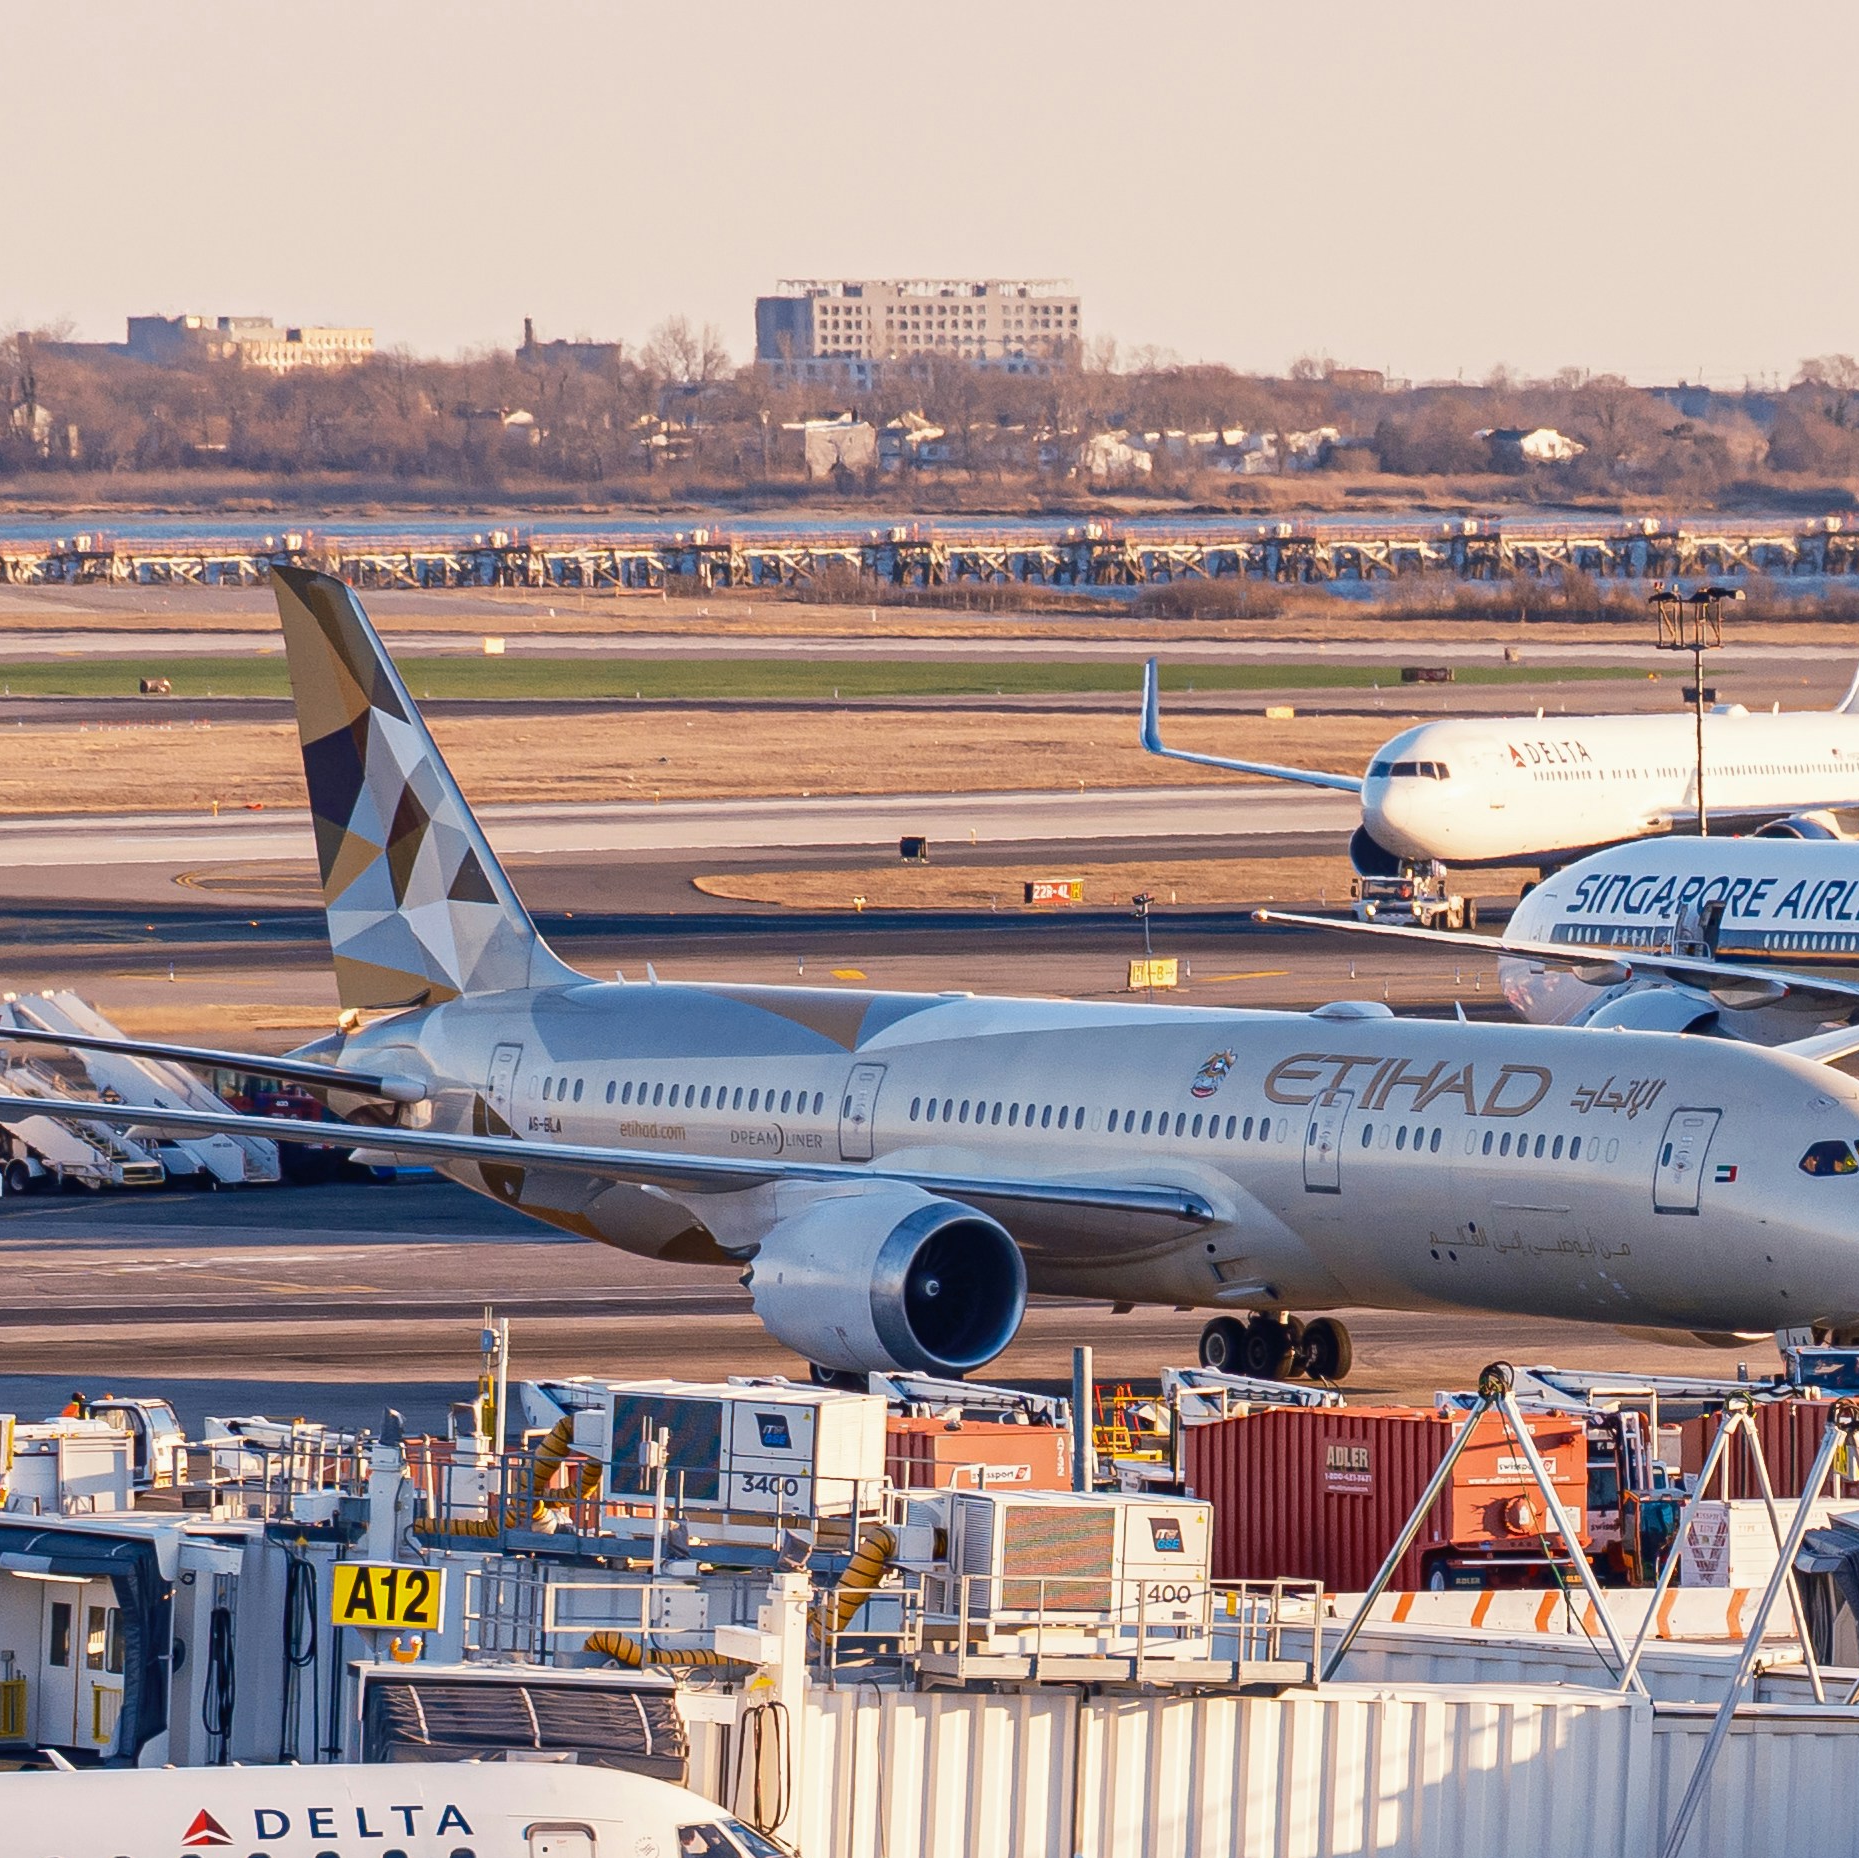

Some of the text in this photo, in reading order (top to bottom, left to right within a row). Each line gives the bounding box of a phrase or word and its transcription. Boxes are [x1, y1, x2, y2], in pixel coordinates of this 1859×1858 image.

[1524, 740, 1593, 764] DELTA
[1033, 884, 1070, 899] 22R-4L
[1566, 873, 1778, 920] SINGAPORE
[1264, 1052, 1553, 1119] ETIHAD
[528, 1117, 563, 1134] A6-BLA
[620, 1121, 687, 1142] etihad.com
[1326, 1445, 1369, 1469] ADLER
[741, 1474, 799, 1497] 3400
[343, 1566, 430, 1623] A12
[1137, 1584, 1191, 1605] 400
[255, 1804, 474, 1839] DELTA
